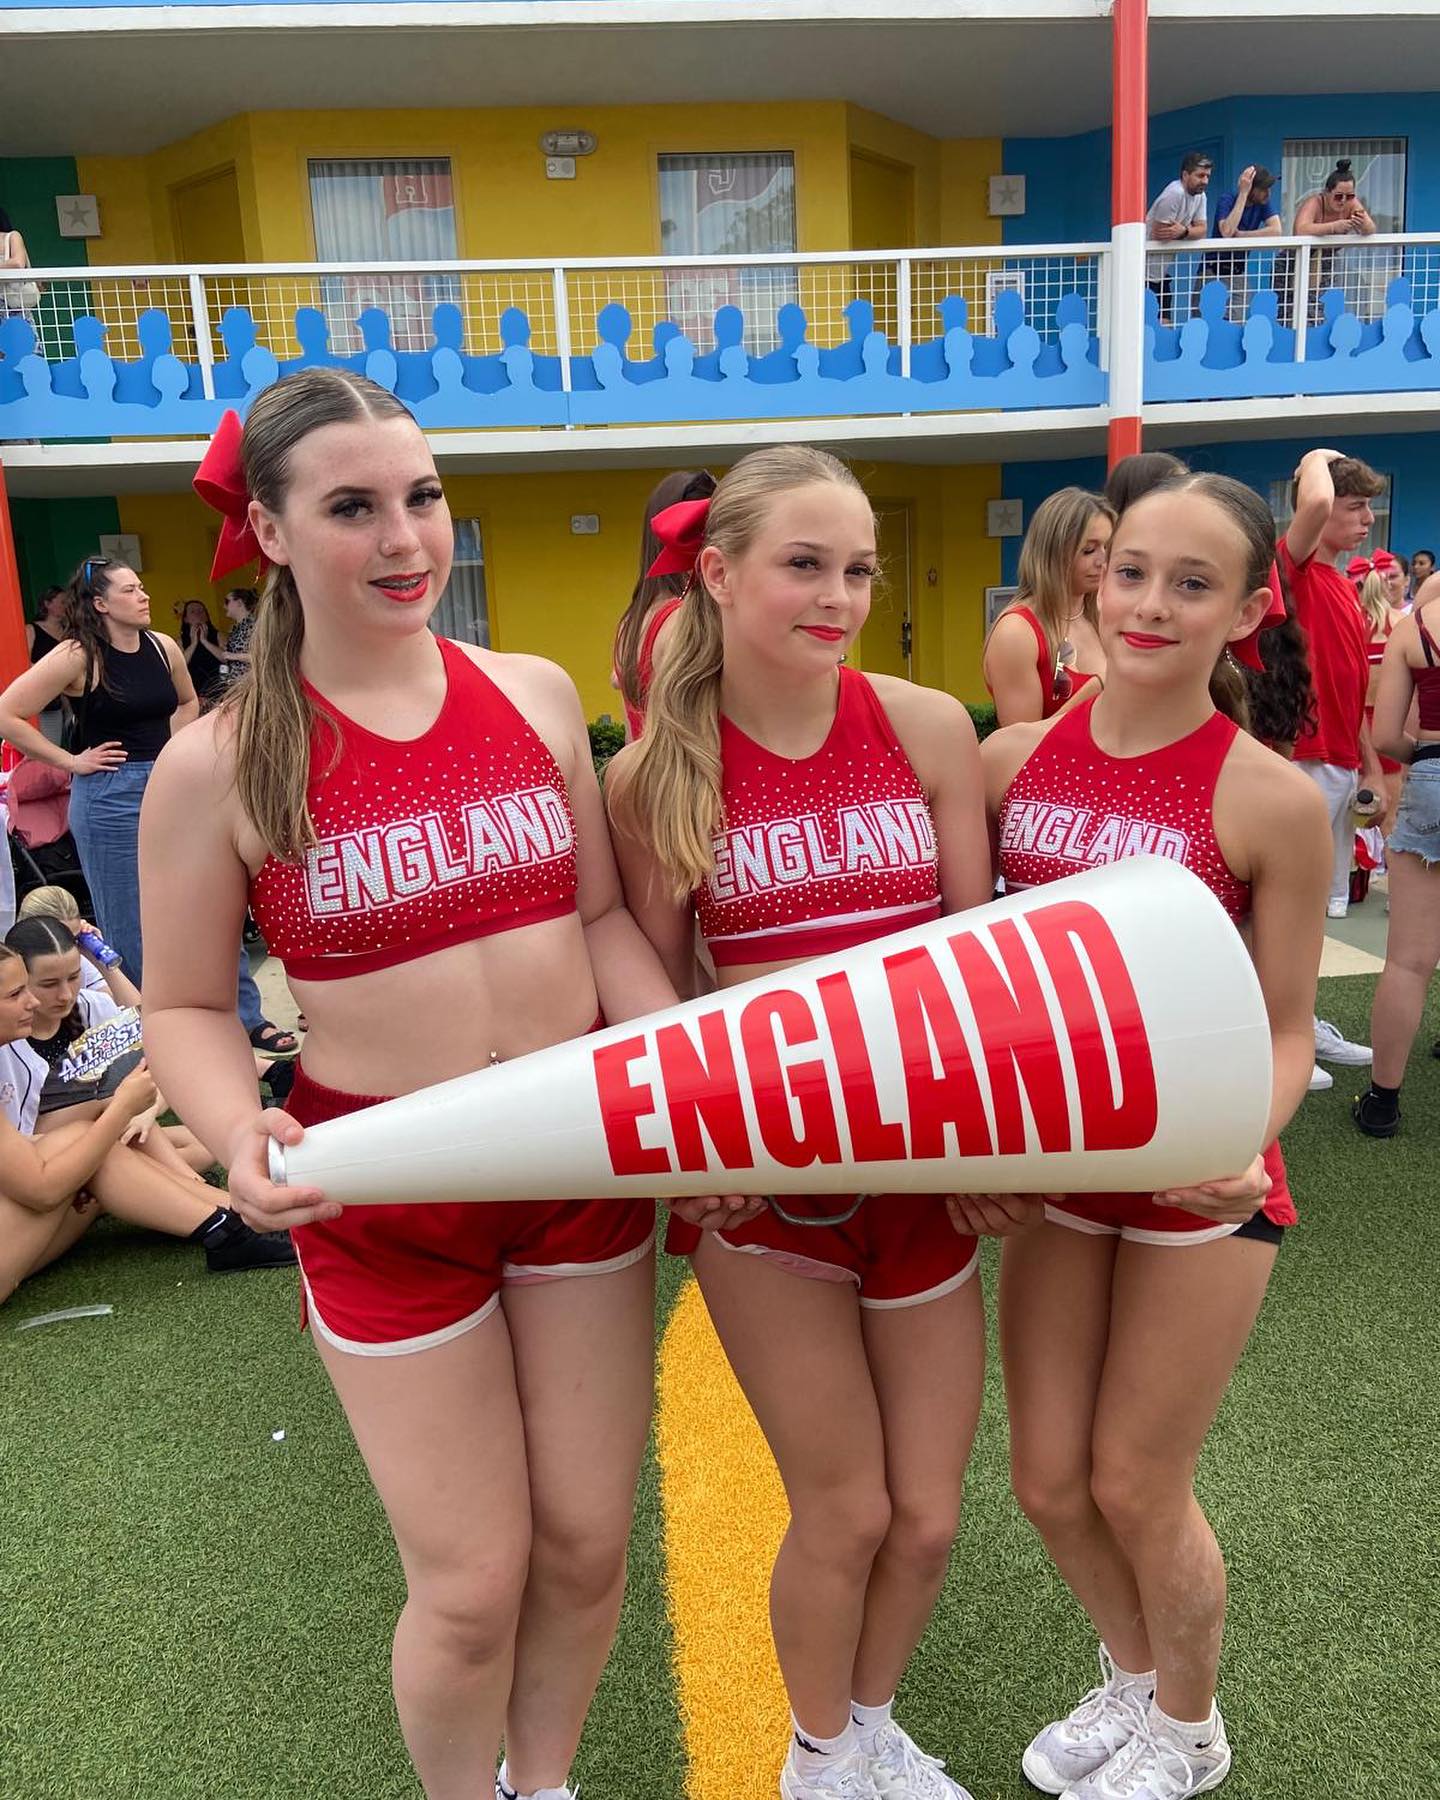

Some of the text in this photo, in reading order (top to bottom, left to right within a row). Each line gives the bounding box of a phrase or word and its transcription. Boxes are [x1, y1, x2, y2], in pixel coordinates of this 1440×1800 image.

[304, 785, 574, 919] ENGLAND
[710, 799, 939, 905] ENGLAND
[1000, 800, 1190, 867] ENGLAND
[58, 1019, 143, 1077] ALL ST
[62, 1032, 143, 1083] NATIONAL CHAMPIO
[87, 1025, 116, 1048] NCA
[592, 900, 1158, 1176] ENGLAND
